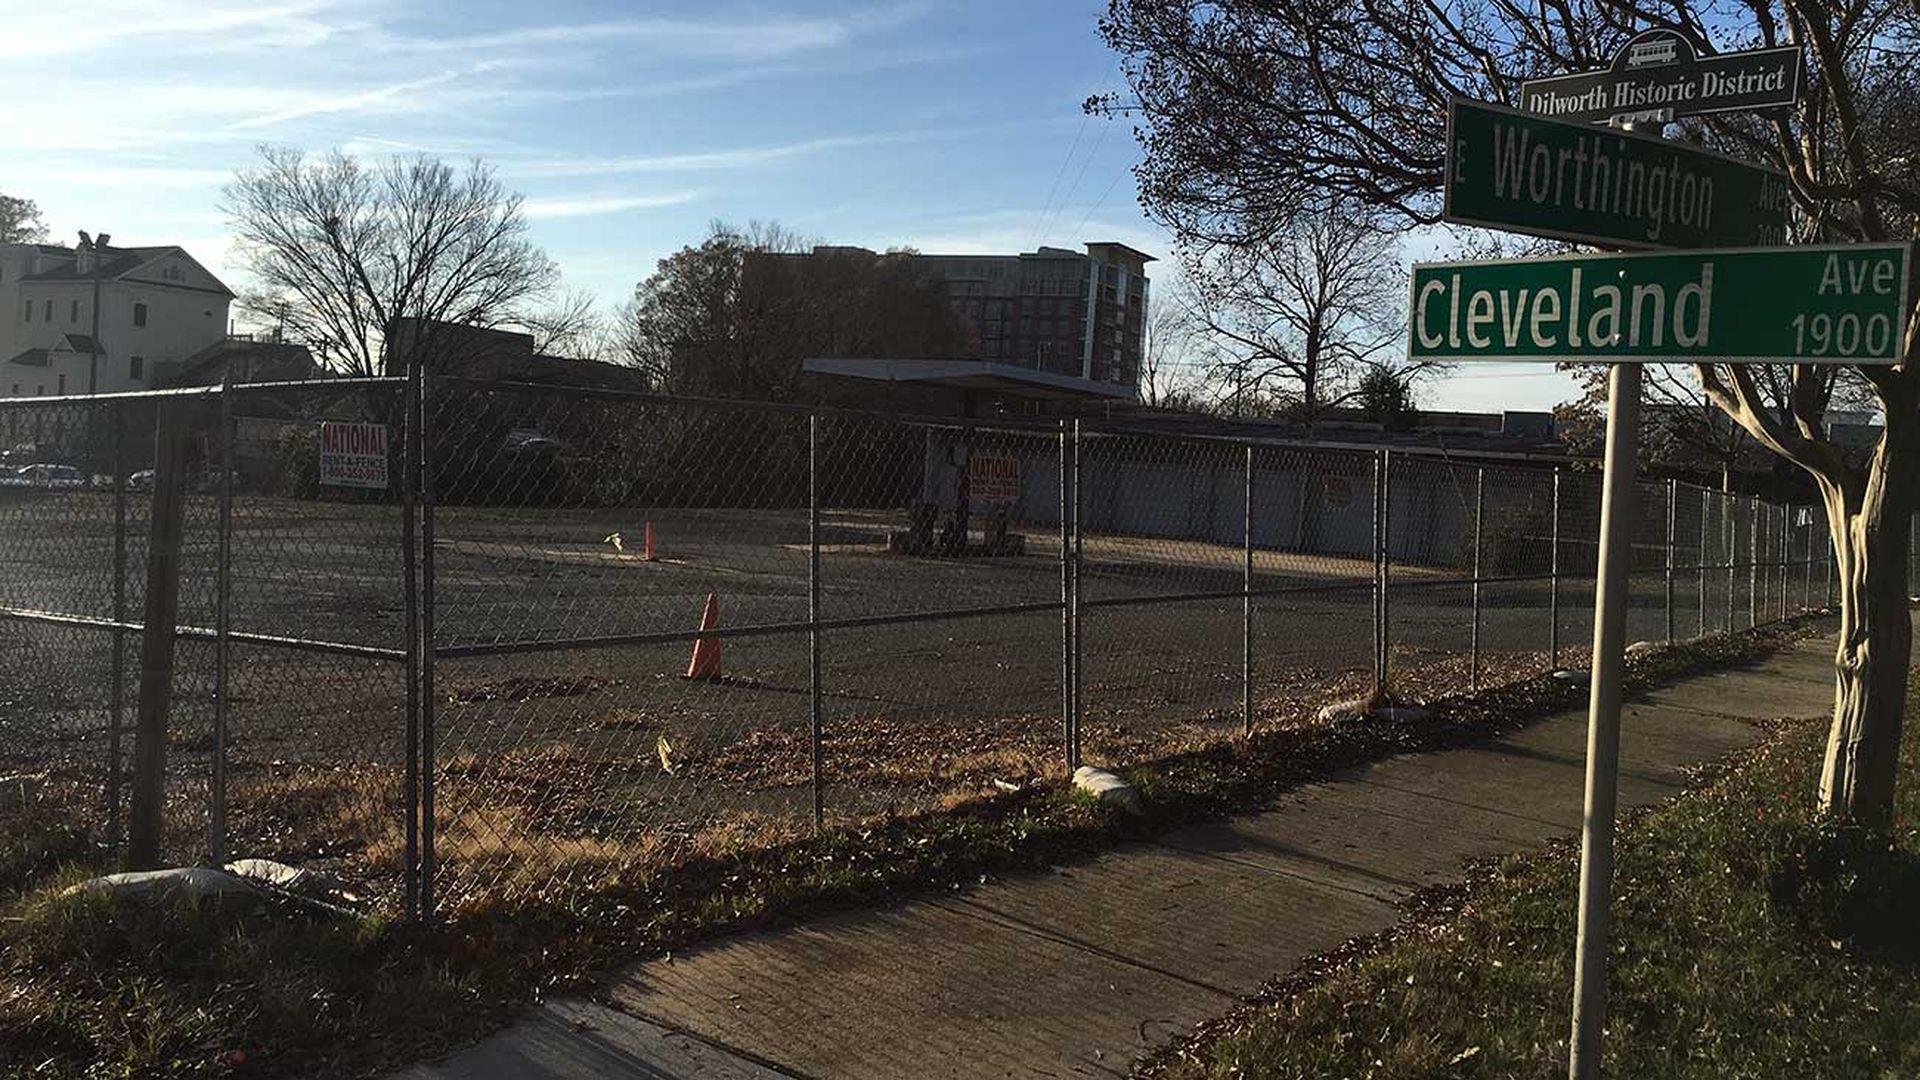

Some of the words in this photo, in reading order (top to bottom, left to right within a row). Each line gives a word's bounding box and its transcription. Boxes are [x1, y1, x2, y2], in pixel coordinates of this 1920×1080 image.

[1529, 85, 1607, 115] Dilworth
[1612, 75, 1697, 108] Historic
[1701, 65, 1785, 99] District
[1455, 139, 1467, 184] E
[1493, 123, 1714, 241] Worthington
[1758, 172, 1785, 212] Ave
[1416, 262, 1715, 350] Cleveland
[1817, 252, 1896, 296] Ave
[1792, 312, 1891, 357] 1900
[323, 424, 385, 455] NATIONAL
